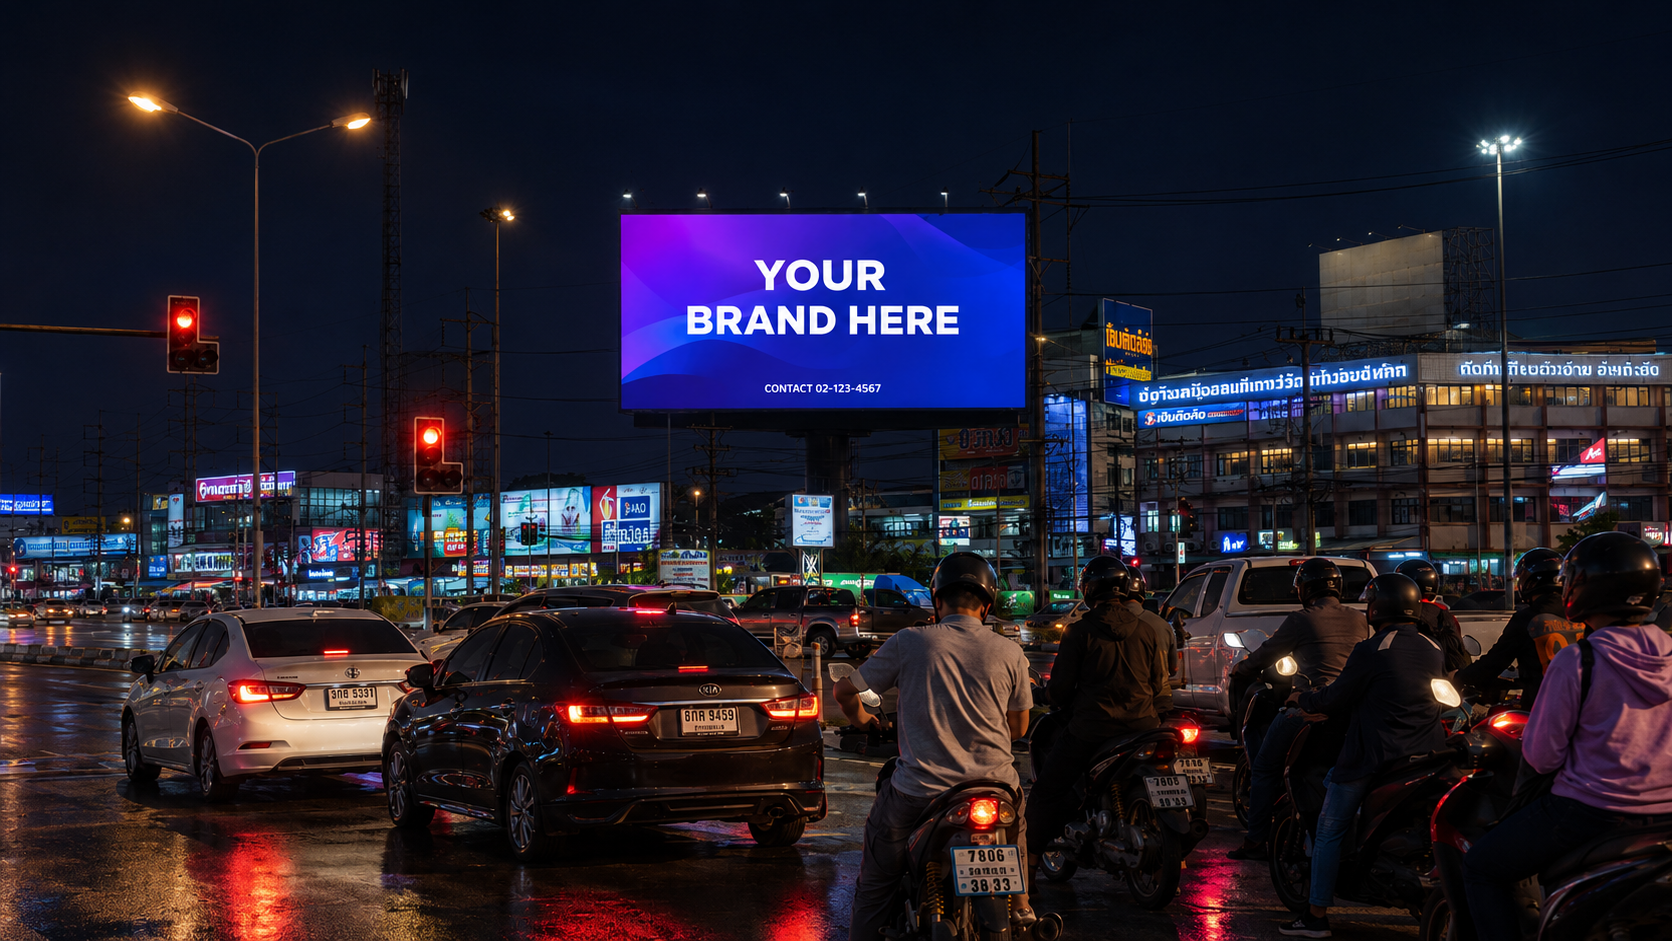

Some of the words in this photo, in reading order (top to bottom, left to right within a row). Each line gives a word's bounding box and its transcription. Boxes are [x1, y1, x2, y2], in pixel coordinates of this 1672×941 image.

[754, 259, 886, 291] YOUR
[686, 305, 837, 335] BRAND
[849, 305, 960, 335] HERE
[764, 383, 813, 394] CONTACT
[815, 383, 882, 394] 02-123-4567
[702, 686, 719, 695] KIA
[967, 849, 1005, 862] 7806
